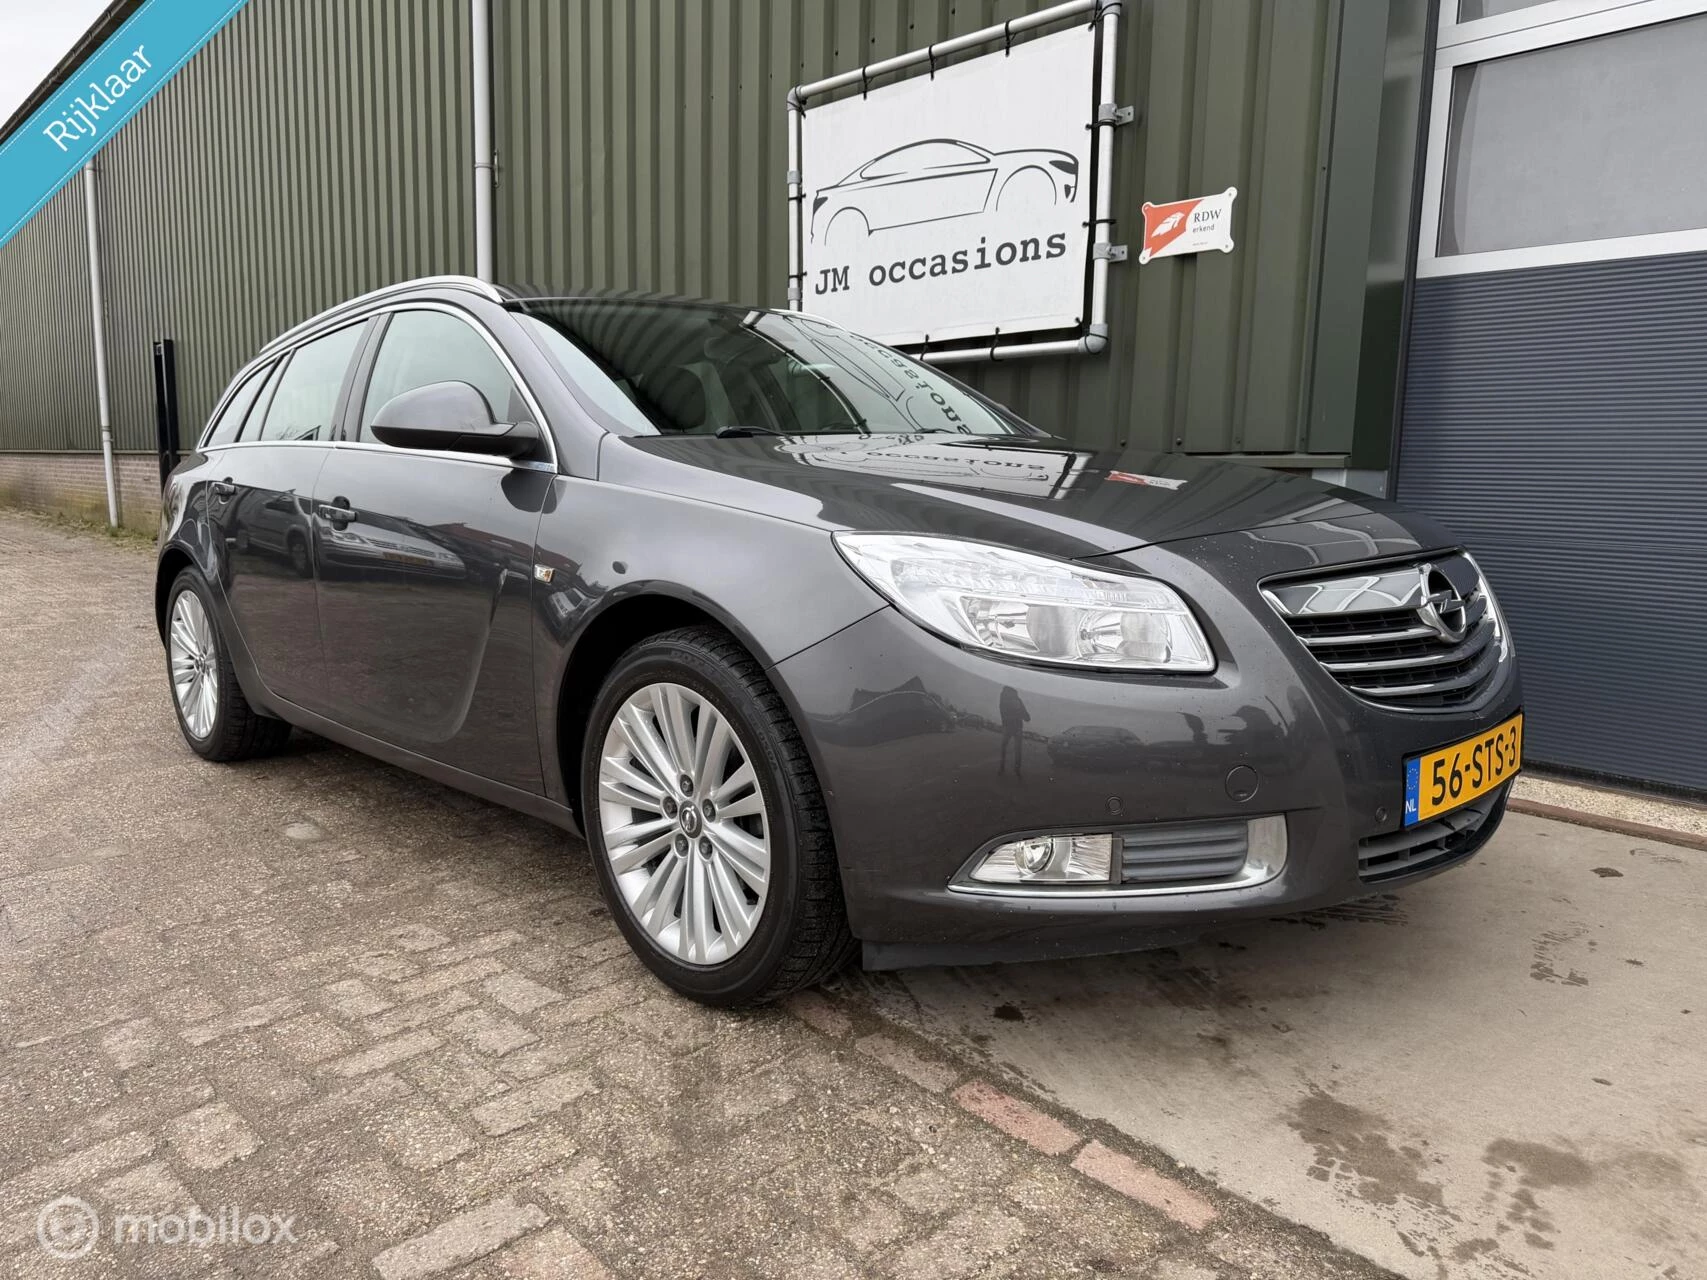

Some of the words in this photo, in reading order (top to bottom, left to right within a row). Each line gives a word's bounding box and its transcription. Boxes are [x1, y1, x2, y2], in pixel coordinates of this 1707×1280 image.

[1192, 223, 1215, 233] erkend
[1193, 208, 1222, 223] RDW
[815, 265, 850, 295] JM
[868, 232, 1067, 286] occasions
[1405, 798, 1417, 814] NL
[1431, 726, 1517, 806] 56-STS-3
